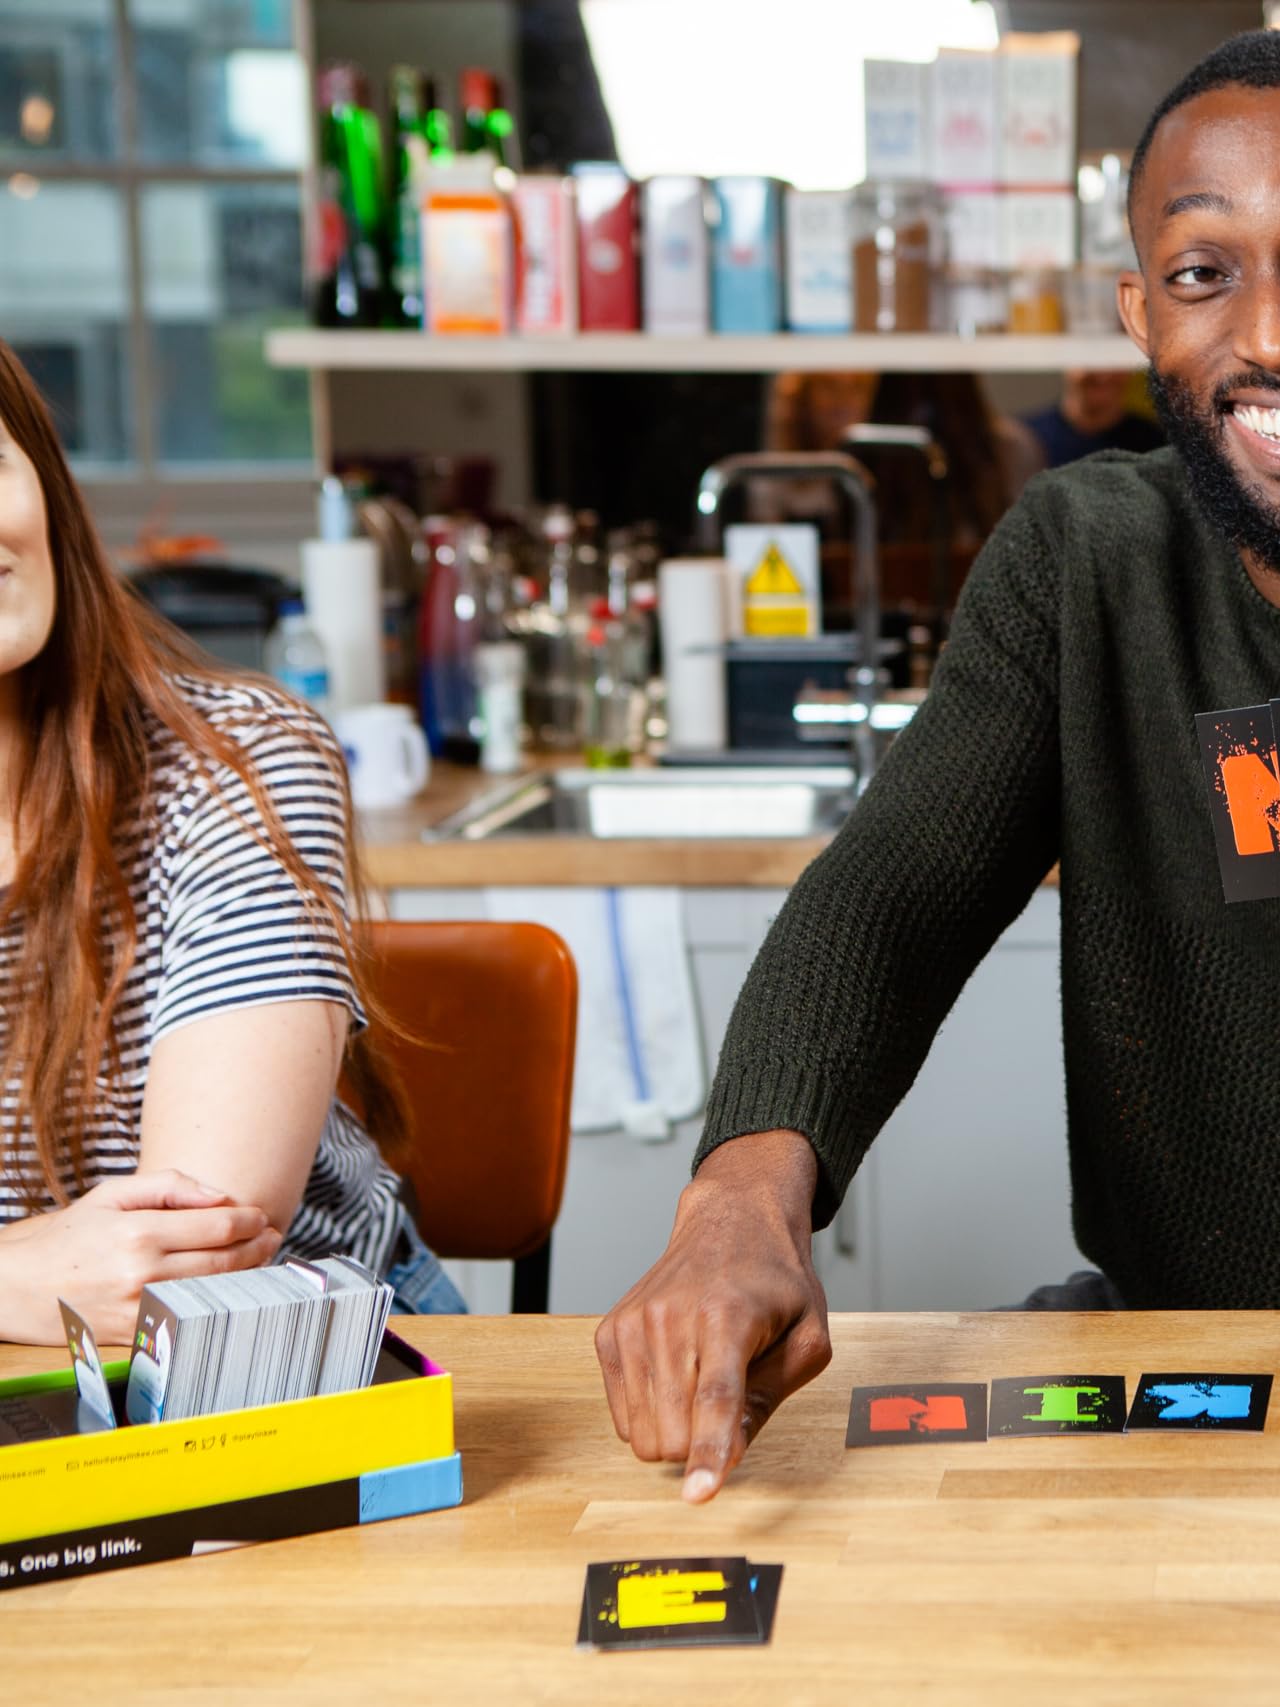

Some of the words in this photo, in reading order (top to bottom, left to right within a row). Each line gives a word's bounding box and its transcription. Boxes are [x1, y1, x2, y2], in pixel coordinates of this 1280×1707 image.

[1023, 1387, 1101, 1422] I
[63, 1544, 97, 1566] big
[101, 1536, 142, 1559] link.
[617, 1570, 727, 1629] E
